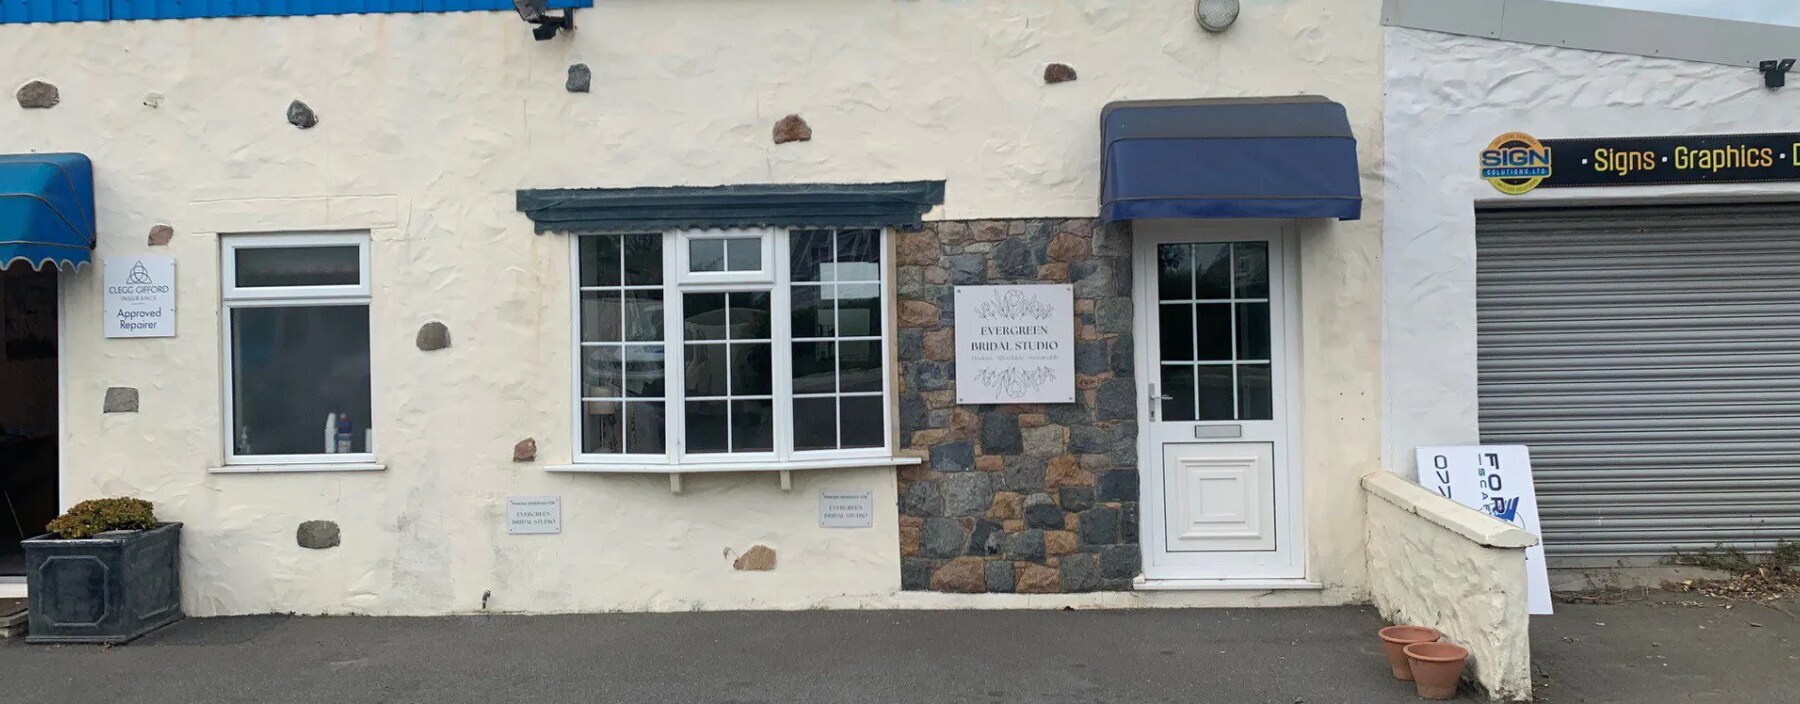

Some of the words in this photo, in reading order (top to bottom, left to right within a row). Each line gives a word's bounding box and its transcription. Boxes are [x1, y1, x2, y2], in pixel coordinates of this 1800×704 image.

[1481, 149, 1549, 167] SIGN
[1594, 148, 1655, 176] Signs
[1674, 145, 1773, 173] Graphics
[1486, 168, 1529, 176] SOLUTIONS
[109, 286, 134, 294] CLEGG
[135, 285, 169, 294] GIFFORD
[117, 306, 161, 320] Approved
[120, 320, 157, 331] Repairer
[980, 325, 1048, 335] EVERGREEN
[971, 341, 1013, 351] BRIDAL
[1015, 340, 1058, 350] STUDIO
[1478, 468, 1492, 515] SCAF
